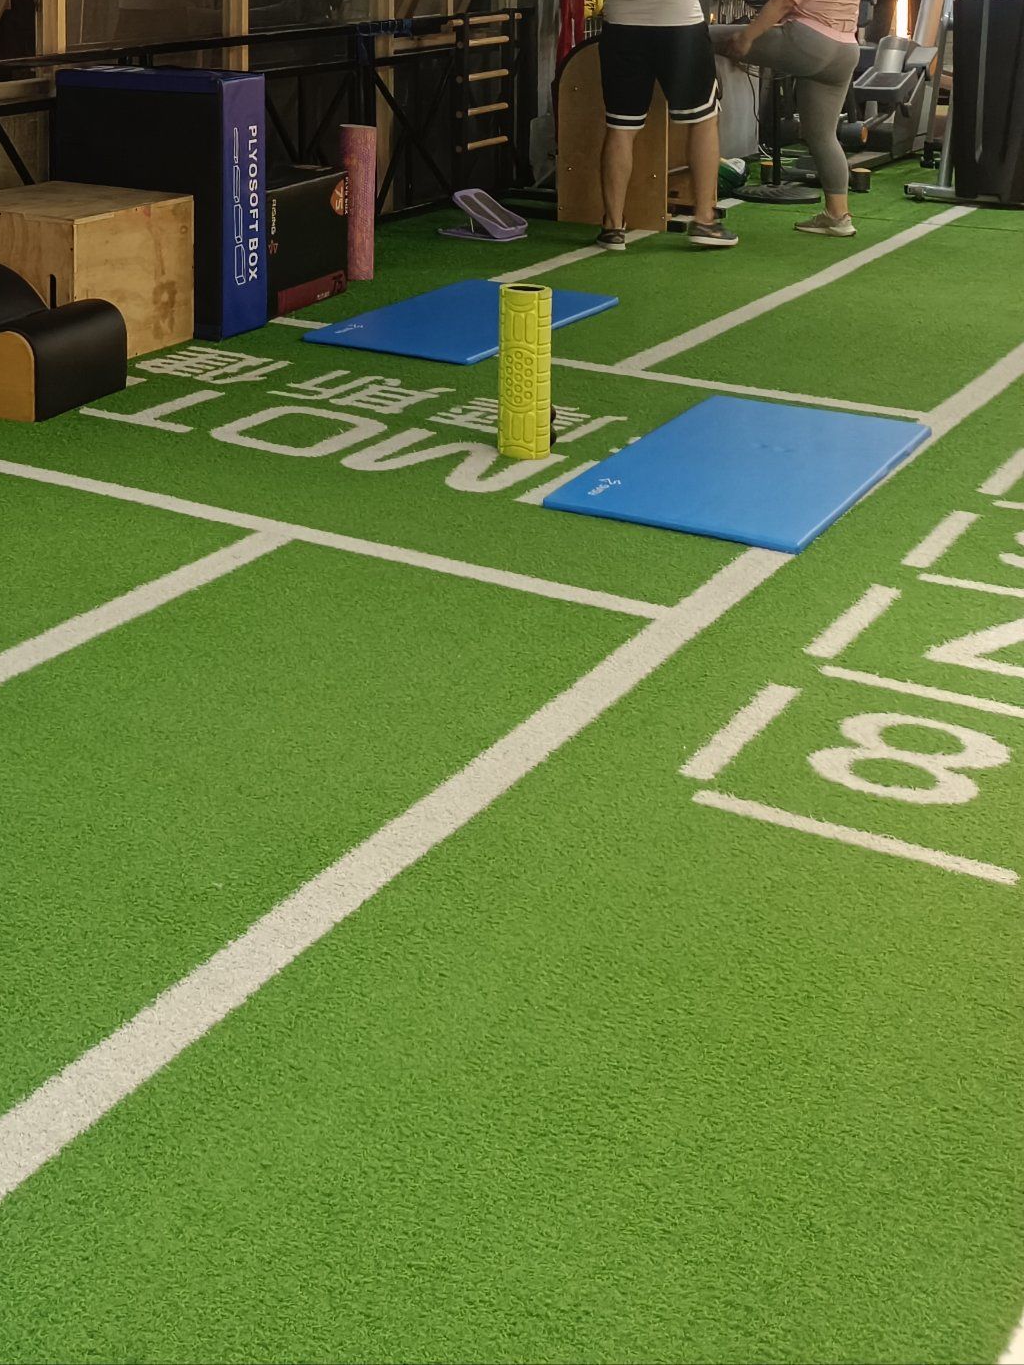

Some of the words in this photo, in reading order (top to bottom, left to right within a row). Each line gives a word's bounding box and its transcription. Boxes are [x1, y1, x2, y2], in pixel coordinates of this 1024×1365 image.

[248, 124, 259, 232] PLYOSOFT
[335, 186, 344, 211] 75
[248, 237, 259, 282] BOX
[806, 712, 1011, 805] 8
